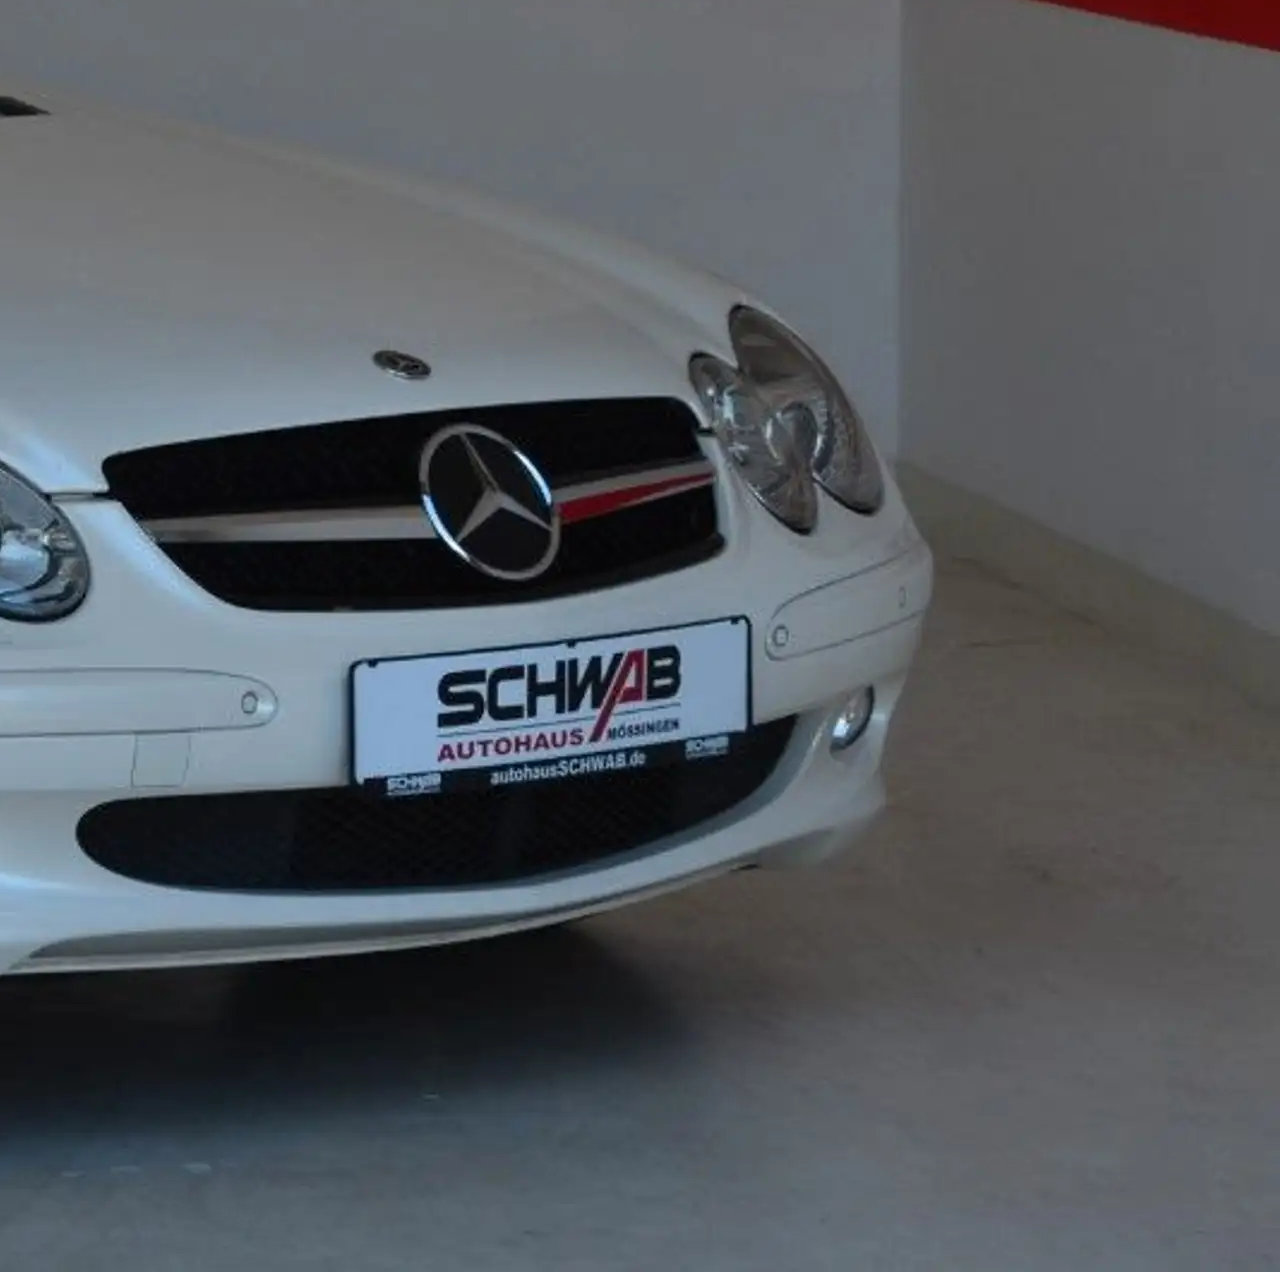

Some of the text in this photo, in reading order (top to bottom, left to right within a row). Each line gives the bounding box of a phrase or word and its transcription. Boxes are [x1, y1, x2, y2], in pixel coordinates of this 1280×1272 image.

[437, 644, 681, 742] SCHWAB
[437, 729, 584, 762] AUTOHAUS
[490, 751, 646, 786] autohausSCHWAB.de
